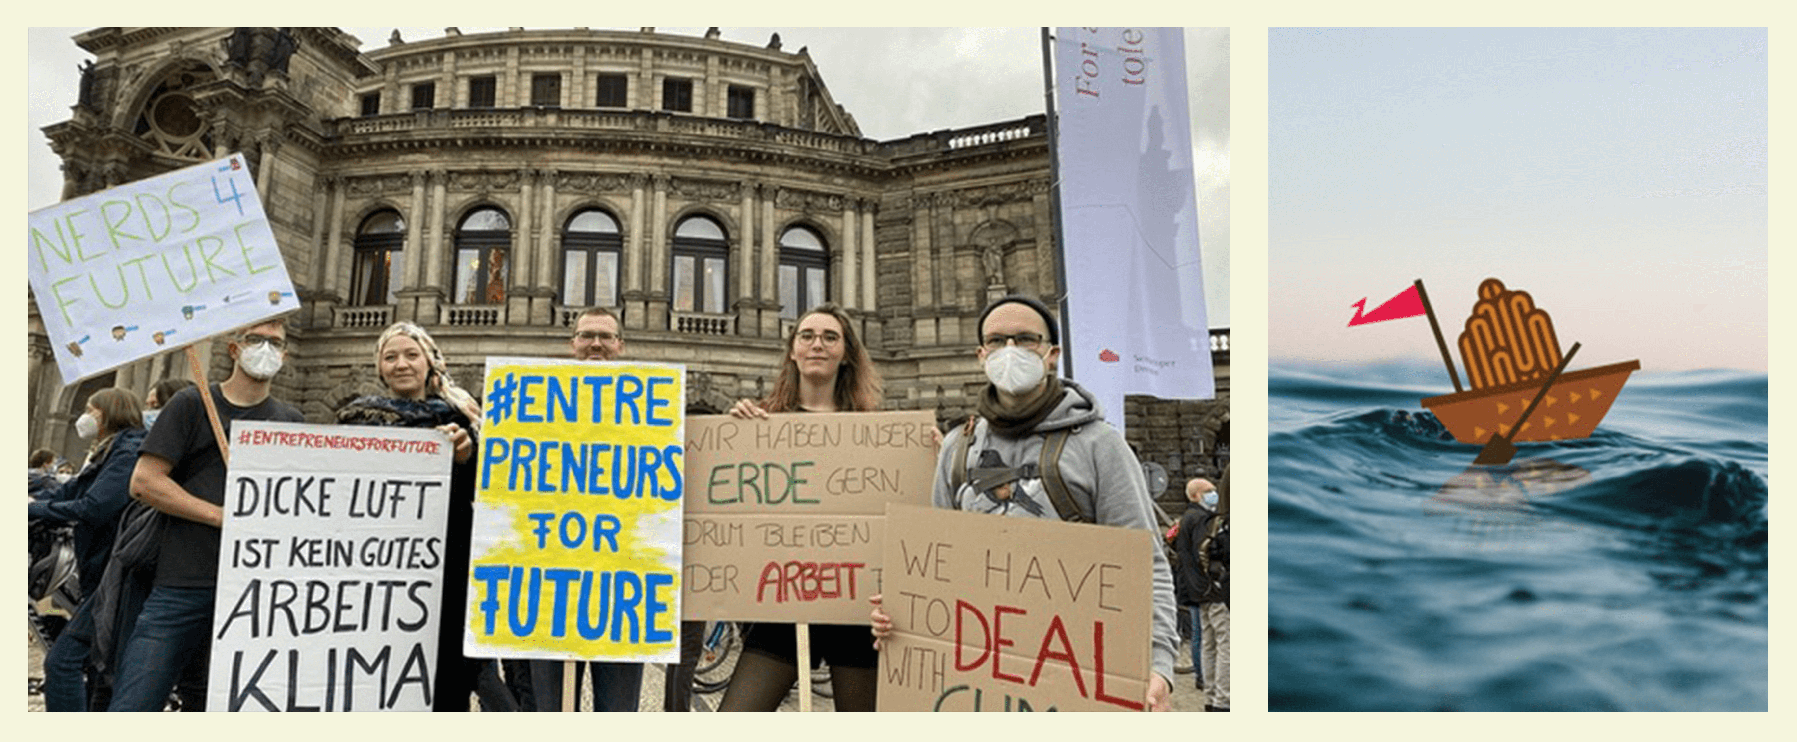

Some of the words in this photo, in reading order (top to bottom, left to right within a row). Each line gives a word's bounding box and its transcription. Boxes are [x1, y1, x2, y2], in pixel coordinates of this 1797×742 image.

[1075, 42, 1100, 98] For
[31, 182, 200, 275] NERDS
[211, 176, 246, 216] 4
[51, 220, 280, 328] FUTURE
[486, 372, 674, 426] #ENTRE
[238, 430, 442, 455] #ENTREPRENEURSFORFUTURE
[755, 420, 842, 450] HABEN
[851, 423, 936, 449] UNSERE
[481, 437, 683, 501] PRENEURS
[707, 460, 821, 506] ERDE
[825, 466, 904, 497] GERN.
[232, 476, 336, 518] DICKE
[348, 478, 443, 520] LUFT
[232, 539, 280, 569] IST
[288, 536, 354, 568] KEIN
[359, 537, 442, 570] GUTES
[527, 511, 622, 553] FOR
[683, 518, 745, 548] DRUM
[754, 521, 871, 549] BLEIBEN
[685, 563, 741, 595] DER
[756, 560, 866, 604] ARBEIT
[900, 539, 953, 583] WE
[984, 549, 1123, 613] HAVE
[216, 578, 433, 641] ARBEITS
[473, 565, 674, 644] FUTURE
[227, 642, 433, 712] KLIMA
[884, 643, 947, 693] WITH
[899, 591, 950, 637] TO
[954, 599, 1145, 710] DEAL
